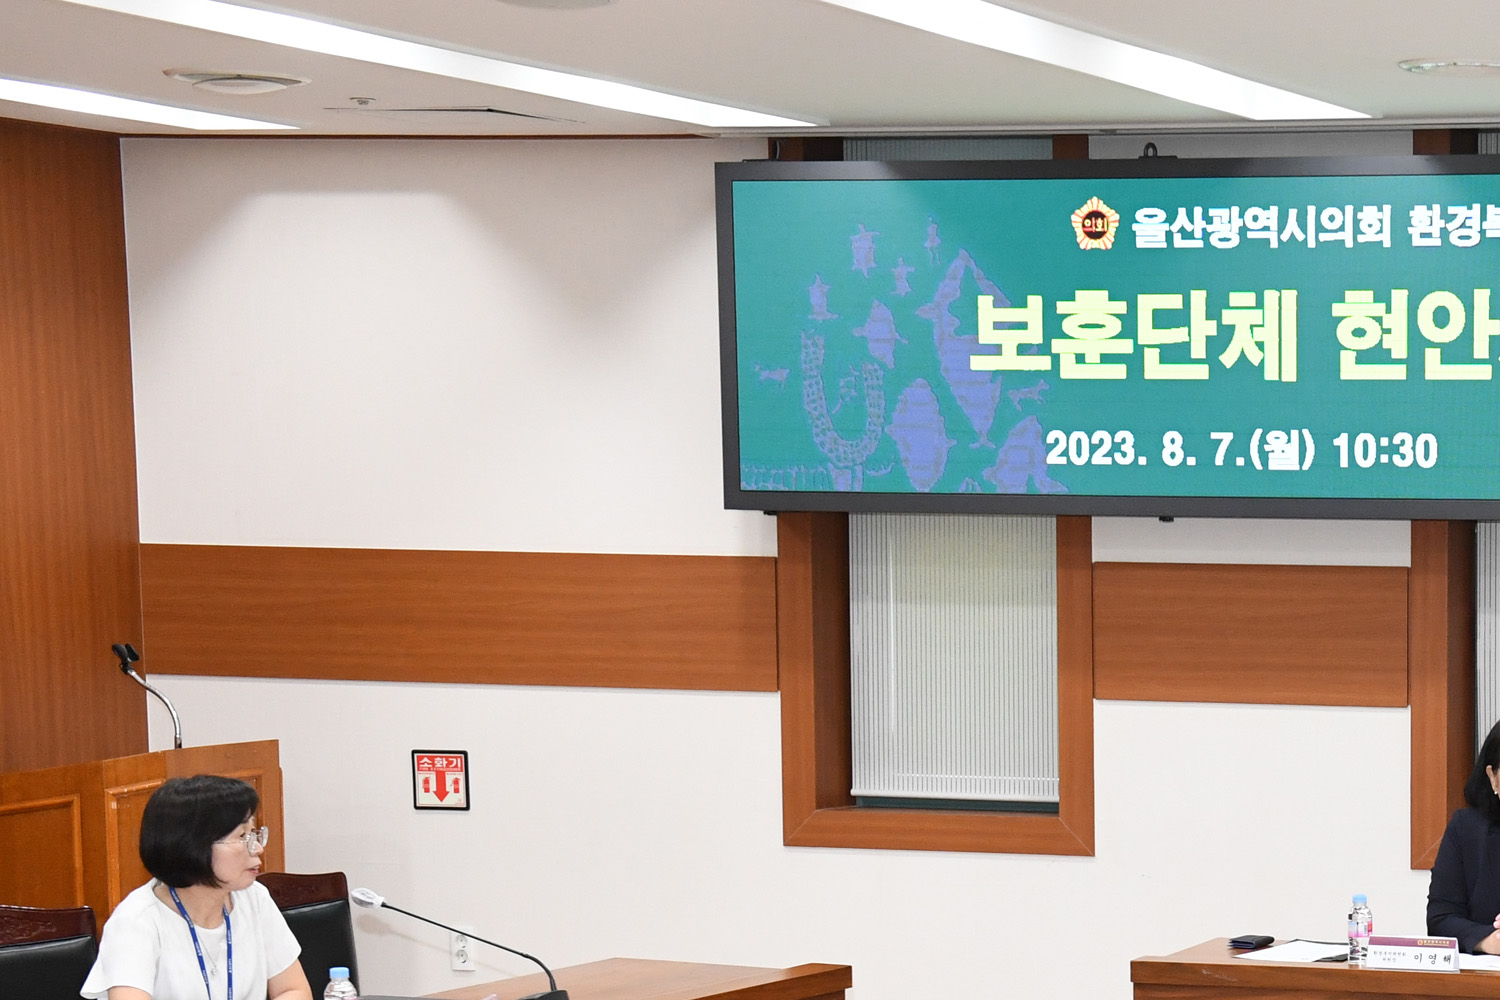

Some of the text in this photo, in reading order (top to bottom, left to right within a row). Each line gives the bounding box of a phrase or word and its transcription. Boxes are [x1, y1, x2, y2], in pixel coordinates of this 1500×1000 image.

[1082, 217, 1108, 233] 의회
[1131, 204, 1392, 249] 울산광역시의회
[969, 289, 1298, 383] 보훈단체
[1046, 429, 1438, 471] 2023. 8. 7.(월) 10:30
[419, 757, 461, 768] 소화기
[1413, 952, 1452, 966] 이영해
